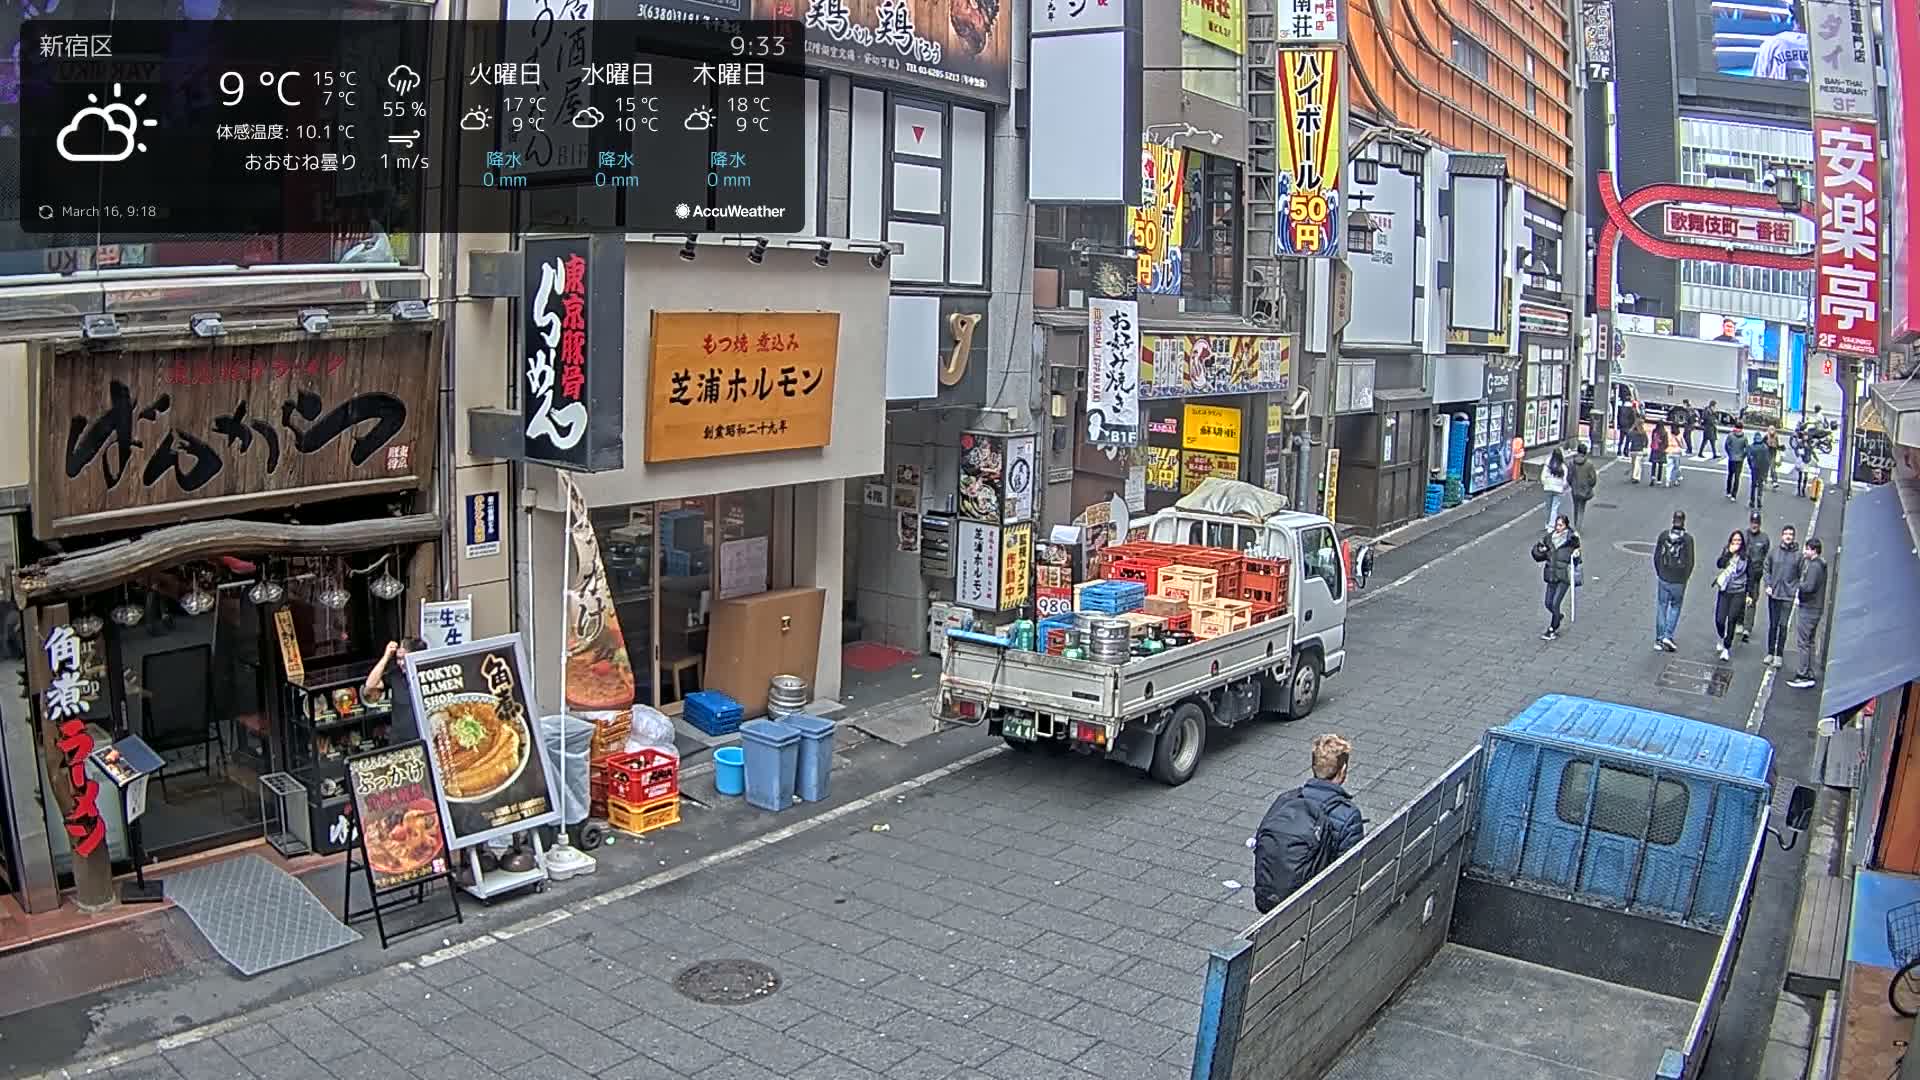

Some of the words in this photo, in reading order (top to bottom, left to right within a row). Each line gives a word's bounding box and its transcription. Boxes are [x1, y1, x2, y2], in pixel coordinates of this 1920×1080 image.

[1818, 14, 1843, 70] タイ
[1589, 63, 1609, 79] 7F
[1833, 97, 1856, 111] 3F
[1295, 55, 1321, 189] ハイボール
[1289, 195, 1327, 221] 50
[1134, 220, 1157, 251] 50
[1296, 223, 1320, 252] 円
[1670, 211, 1790, 242] 歌舞伎町一番街
[1820, 127, 1876, 330] 安楽亭
[562, 254, 586, 400] 東京豚骨
[1819, 333, 1836, 347] 2F
[704, 333, 749, 354] もつ焼
[756, 332, 800, 354] 煮込み
[1106, 310, 1135, 413] お好み焼き
[669, 366, 823, 406] 芝浦ホルモン
[703, 419, 788, 440] 創業昭和二十九年
[1110, 431, 1136, 443] B1F
[1038, 598, 1071, 615] 980
[418, 664, 462, 685] TOKYO
[421, 677, 464, 697] RAMEN
[423, 692, 456, 709] SHOP
[357, 758, 425, 794] ぶっかけ
